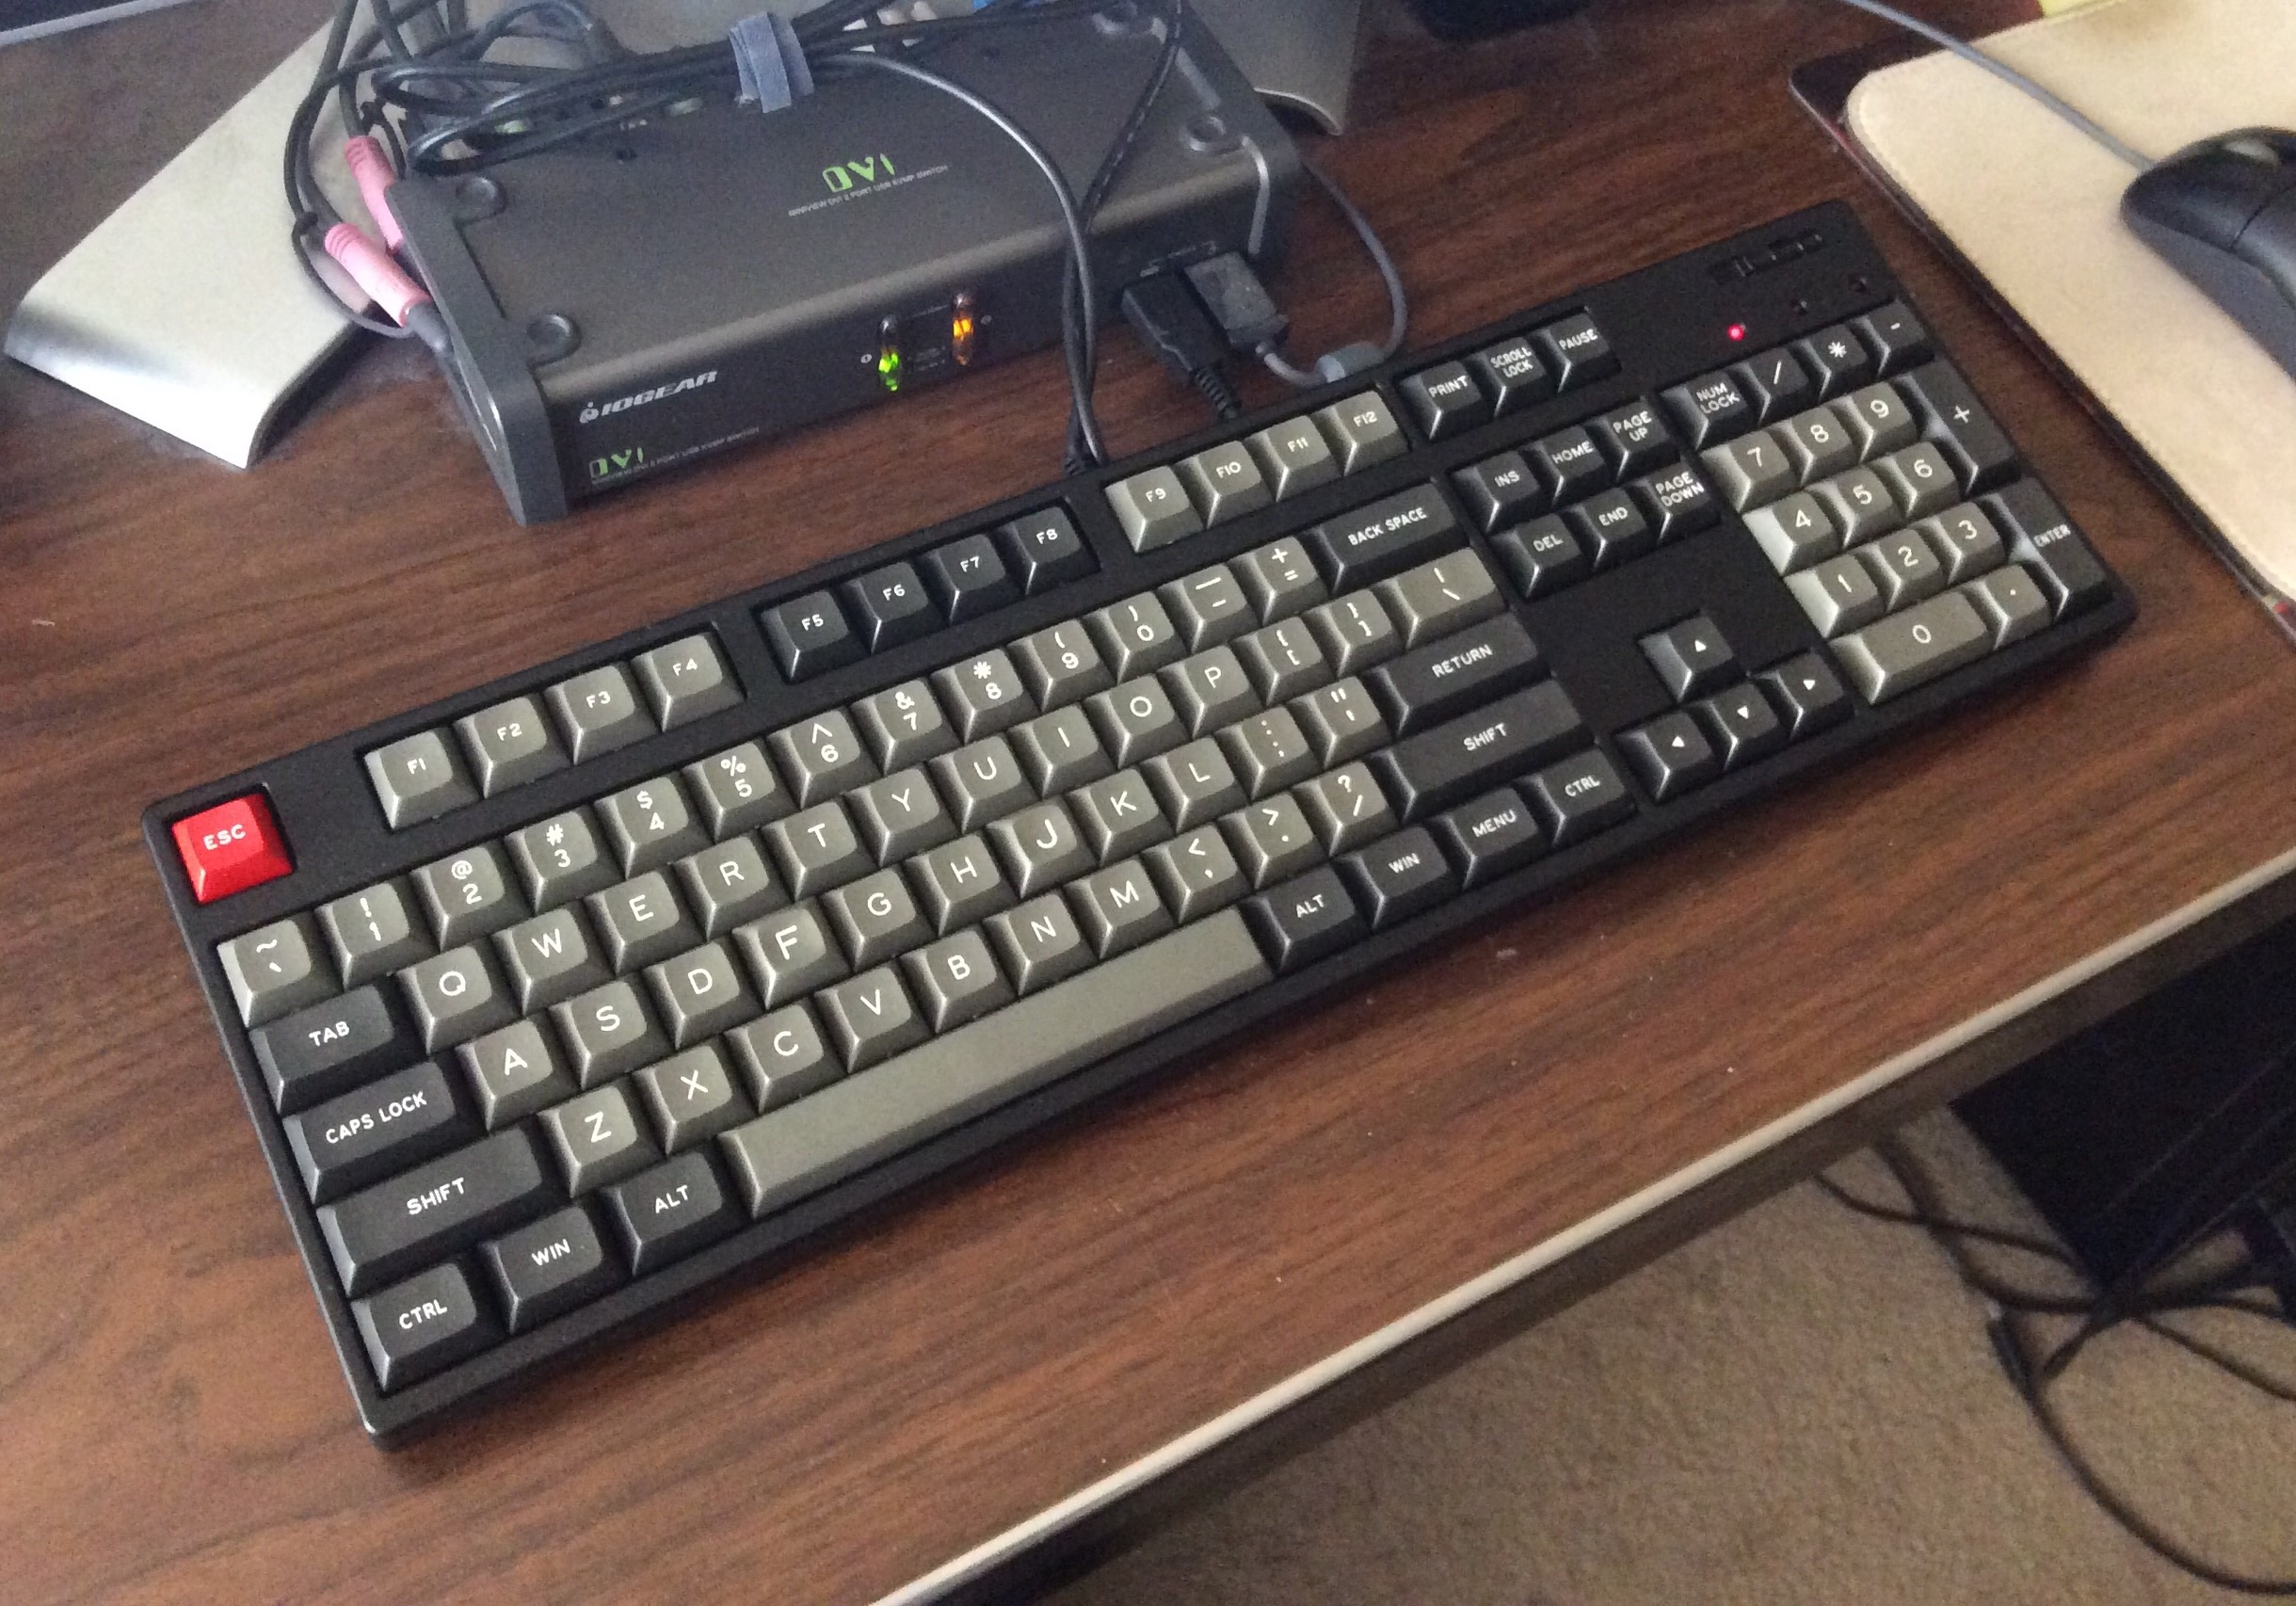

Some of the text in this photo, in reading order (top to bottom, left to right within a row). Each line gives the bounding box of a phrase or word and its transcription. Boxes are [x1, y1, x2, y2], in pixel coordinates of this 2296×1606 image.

[822, 153, 895, 193] DVI
[1559, 329, 1598, 349] PAUSE
[1491, 347, 1533, 369] SCROLL
[1503, 360, 1533, 377] LOCK
[601, 370, 718, 416] IOGEAR
[1429, 376, 1468, 396] PRINT
[1697, 383, 1729, 402] NUM
[1700, 393, 1740, 413] LOCK
[1871, 400, 1888, 418] 9
[1354, 411, 1377, 426] F12
[1614, 410, 1651, 433] PAGE
[1954, 406, 1969, 422] +
[1630, 427, 1647, 441] UP
[1811, 425, 1829, 442] 8
[1288, 438, 1309, 452] F11
[1552, 441, 1593, 463] HOME
[589, 447, 644, 477] DVI
[1747, 447, 1762, 466] 7
[1216, 462, 1241, 477] F10
[1915, 459, 1933, 477] 6
[1495, 471, 1519, 487] INS
[1656, 472, 1694, 495] PAGE
[1146, 489, 1166, 502] F9
[1662, 481, 1704, 506] DOWN
[1854, 485, 1871, 504] 5
[1348, 507, 1427, 545] BACK SPACE
[1599, 507, 1628, 525] END
[1796, 510, 1811, 527] 4
[1036, 529, 1057, 544] F8
[1959, 521, 1977, 539] 3
[2033, 524, 2071, 546] ENTER
[1533, 535, 1563, 551] DEL
[960, 555, 979, 571] F7
[1272, 549, 1288, 563] +
[1899, 546, 1919, 567] 2
[1285, 570, 1298, 580] =
[1838, 575, 1852, 592] 1
[883, 585, 905, 601] F6
[802, 615, 823, 630] F5
[1129, 605, 1138, 621] )
[1137, 625, 1154, 641] 0
[1358, 620, 1372, 636] ]
[1913, 625, 1931, 643] 0
[1055, 632, 1065, 648] (
[673, 658, 698, 676] F4
[1062, 652, 1079, 668] 9
[1287, 650, 1299, 665] [
[1432, 645, 1492, 677] RETURN
[1205, 666, 1221, 688] P
[586, 691, 610, 708] F3
[895, 692, 915, 709] &
[986, 683, 1002, 699] 8
[1131, 697, 1152, 716] O
[497, 723, 522, 740] F2
[904, 712, 917, 731] 7
[1058, 728, 1069, 747] I
[1464, 723, 1506, 750] SHIFT
[821, 745, 838, 762] 6
[408, 758, 425, 774] F1
[721, 756, 746, 776] %
[974, 757, 996, 779] U
[1189, 763, 1210, 782] L
[735, 779, 752, 796] 5
[1338, 775, 1351, 792] ?
[1565, 776, 1600, 796] CTRL
[637, 791, 652, 809] $
[891, 788, 910, 811] Y
[1111, 791, 1136, 815] K
[1354, 795, 1363, 816] /
[650, 812, 664, 829] 4
[1262, 809, 1278, 826] >
[1472, 810, 1516, 837] MENU
[204, 825, 246, 850] ESC
[547, 824, 563, 845] #
[808, 823, 826, 847] T
[1036, 819, 1057, 848] J
[1189, 839, 1205, 855] <
[554, 849, 570, 867] 3
[1389, 853, 1420, 873] WIN
[452, 860, 473, 879] @
[720, 861, 744, 885] R
[951, 857, 977, 883] H
[463, 884, 482, 904] 2
[868, 892, 891, 915] G
[1110, 880, 1139, 907] M
[361, 898, 372, 917] !
[630, 894, 653, 921] E
[1296, 894, 1324, 917] ALT
[370, 922, 381, 940] 1
[1031, 916, 1056, 941] N
[532, 928, 562, 957] W
[776, 925, 797, 959] F
[948, 956, 970, 980] B
[440, 972, 466, 996] Q
[688, 969, 713, 994] D
[860, 989, 881, 1015] V
[597, 1005, 620, 1031] S
[309, 1021, 349, 1046] TAB
[774, 1031, 798, 1056] C
[505, 1049, 527, 1075] A
[681, 1070, 708, 1100] X
[326, 1091, 426, 1143] CAPS LOCK
[585, 1111, 611, 1142] Z
[407, 1178, 464, 1214] SHIFT
[656, 1185, 687, 1213] ALT
[532, 1239, 570, 1265] WIN
[399, 1299, 447, 1328] CTRL
